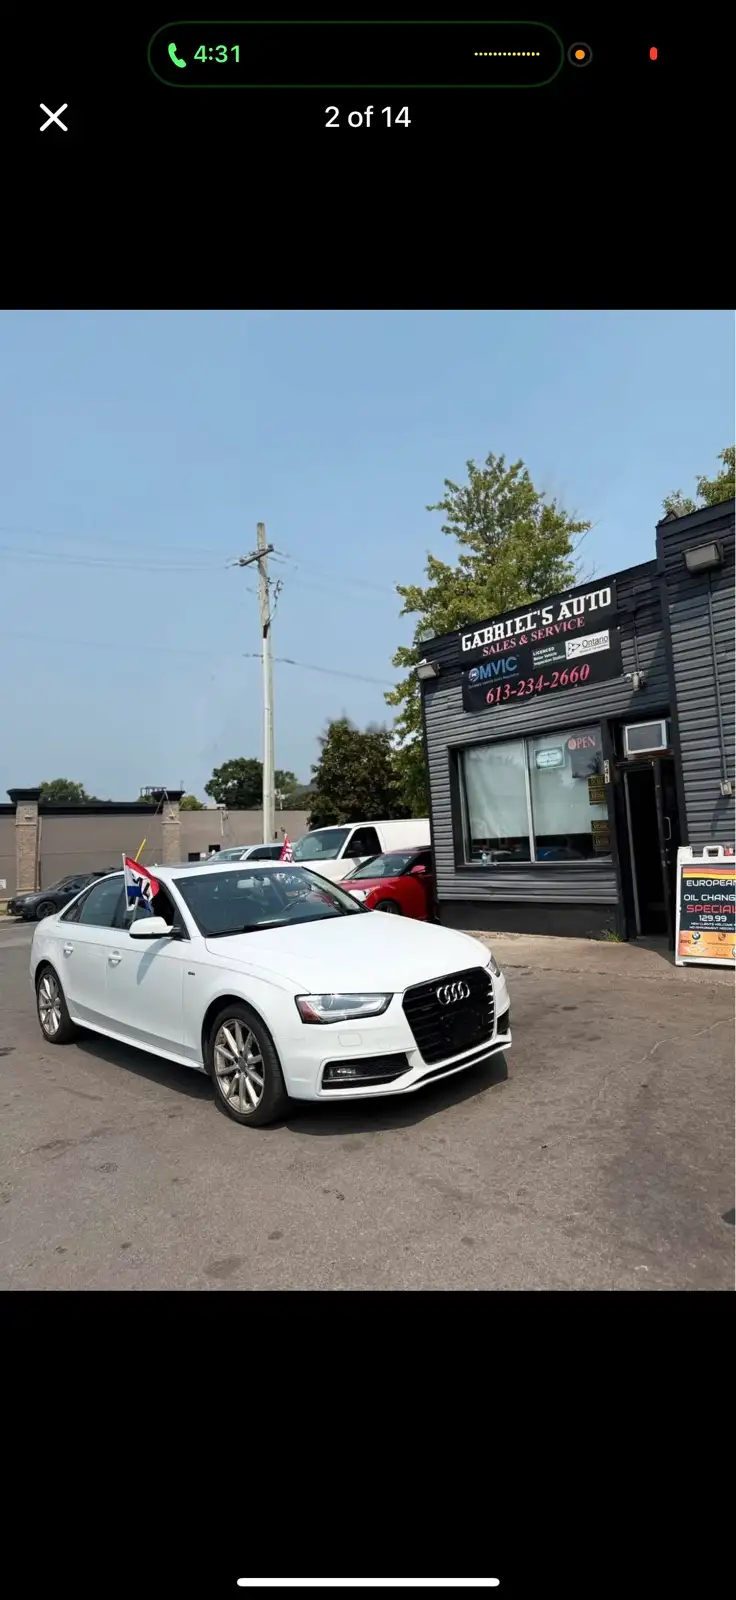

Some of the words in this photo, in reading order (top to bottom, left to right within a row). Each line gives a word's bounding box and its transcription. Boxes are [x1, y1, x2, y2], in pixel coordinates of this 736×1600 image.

[462, 605, 553, 652] GABRIEL'S
[557, 587, 612, 621] AUTO
[482, 638, 516, 657] SALES
[519, 634, 528, 646] &
[530, 616, 585, 642] SERVICE
[582, 635, 608, 649] Ontario
[469, 656, 517, 682] OMVIC
[486, 663, 590, 704] 613-234-2660
[568, 735, 596, 750] OPEN
[683, 894, 699, 902] OIL
[699, 914, 728, 923] 129.99
